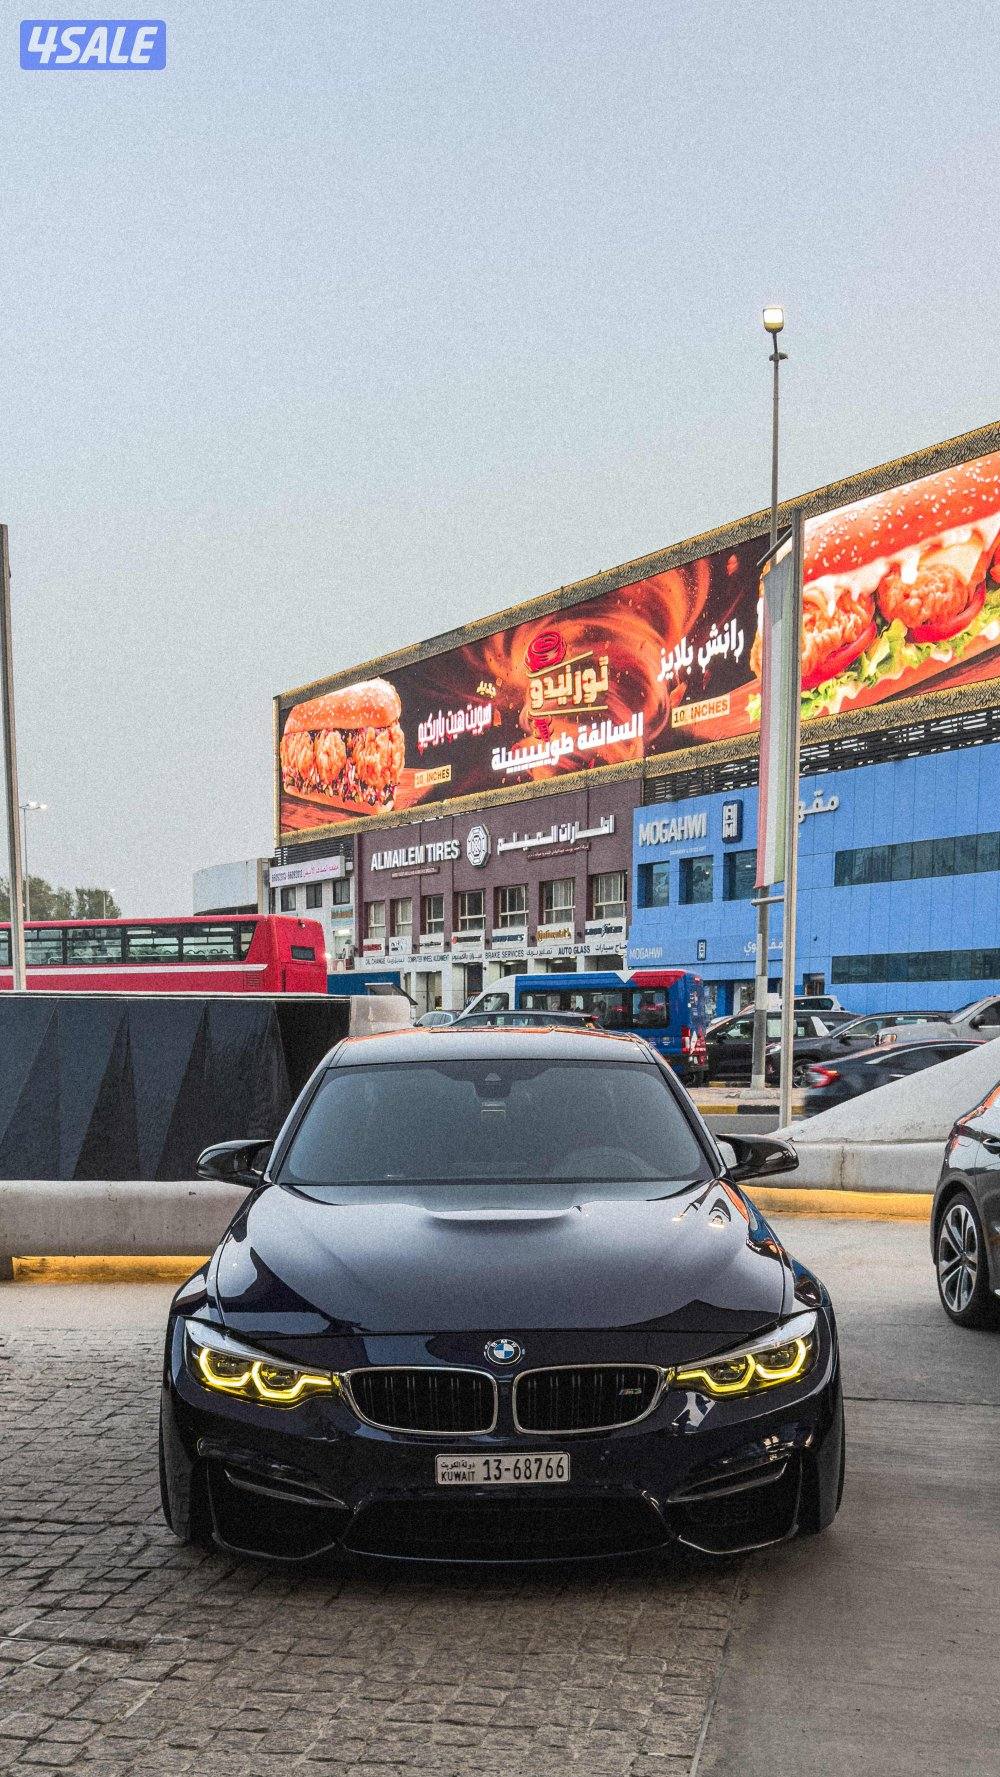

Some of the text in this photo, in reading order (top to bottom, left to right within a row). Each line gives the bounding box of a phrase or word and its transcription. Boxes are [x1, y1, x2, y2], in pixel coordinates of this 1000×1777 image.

[656, 618, 745, 682] رانش بلايز
[475, 680, 497, 699] جديد
[529, 655, 609, 709] تورنيدو
[465, 703, 492, 736] سويت
[673, 700, 729, 724] 10 INCHES
[577, 711, 644, 751] السالفة
[638, 812, 708, 847] MOGAHWI
[370, 839, 461, 871] ALMAILEM TIRES
[485, 949, 524, 960] BRAKE SERVICES
[557, 945, 591, 956] AUTO GLASS
[629, 946, 663, 960] MOGAHWI
[490, 1339, 517, 1348] BMW
[440, 1471, 476, 1482] KUWAIT
[482, 1457, 565, 1481] 13-68766
